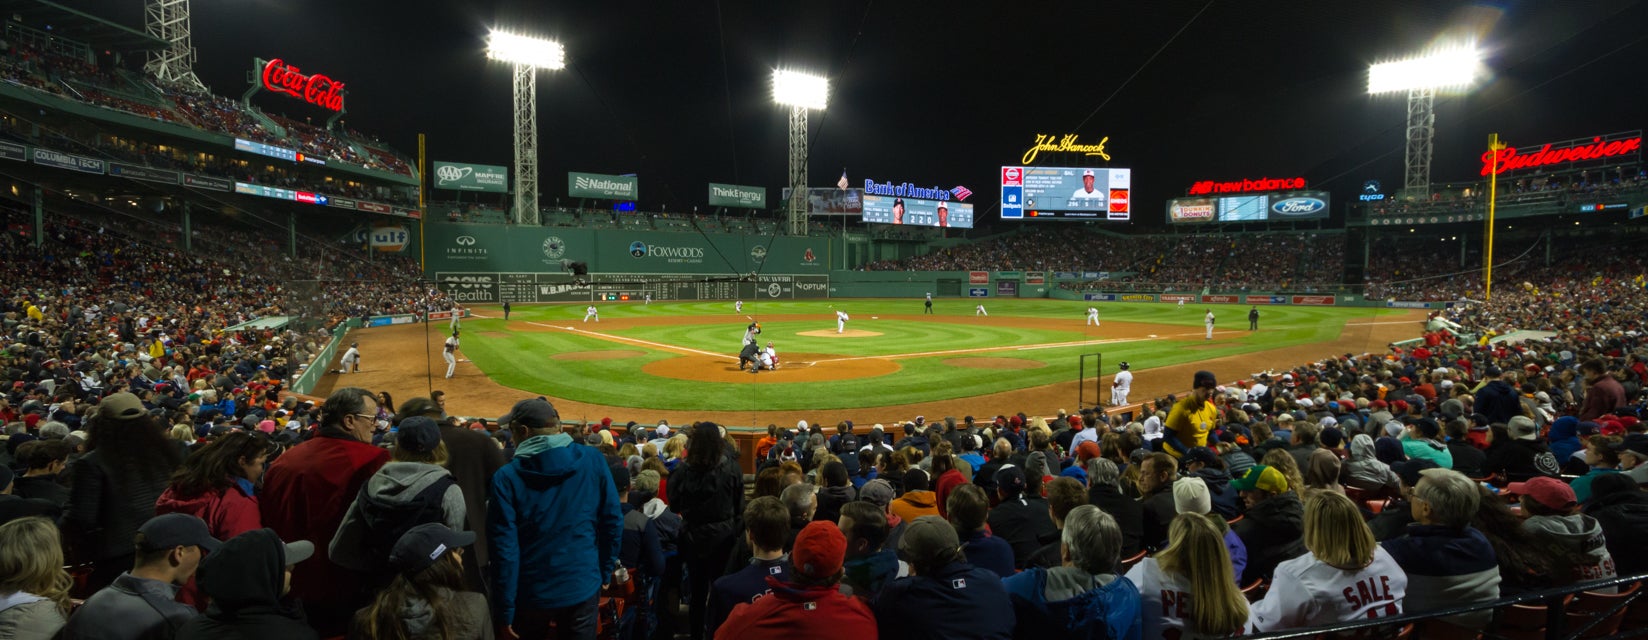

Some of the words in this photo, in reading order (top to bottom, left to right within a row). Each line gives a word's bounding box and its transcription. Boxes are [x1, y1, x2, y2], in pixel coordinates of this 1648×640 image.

[263, 58, 345, 112] Coca-Cola
[1022, 133, 1057, 165] John
[1057, 133, 1111, 161] Hancock
[1480, 136, 1642, 176] Budweiser
[35, 150, 76, 166] COLUMBIA
[78, 158, 100, 170] TECH
[588, 178, 633, 191] National
[865, 178, 895, 197] Bank
[895, 182, 908, 196] of
[907, 183, 950, 201] America
[1213, 182, 1242, 194] new
[1242, 177, 1305, 192] balance
[1359, 193, 1385, 202] tyco
[1281, 200, 1315, 214] Ford
[910, 215, 916, 223] 2
[918, 215, 924, 224] 2
[927, 216, 932, 224] 0
[647, 244, 704, 258] FOXWOODS
[446, 288, 493, 301] Health
[802, 283, 827, 291] OPTUM
[1342, 575, 1394, 611] SALE
[1160, 589, 1192, 618] PE
